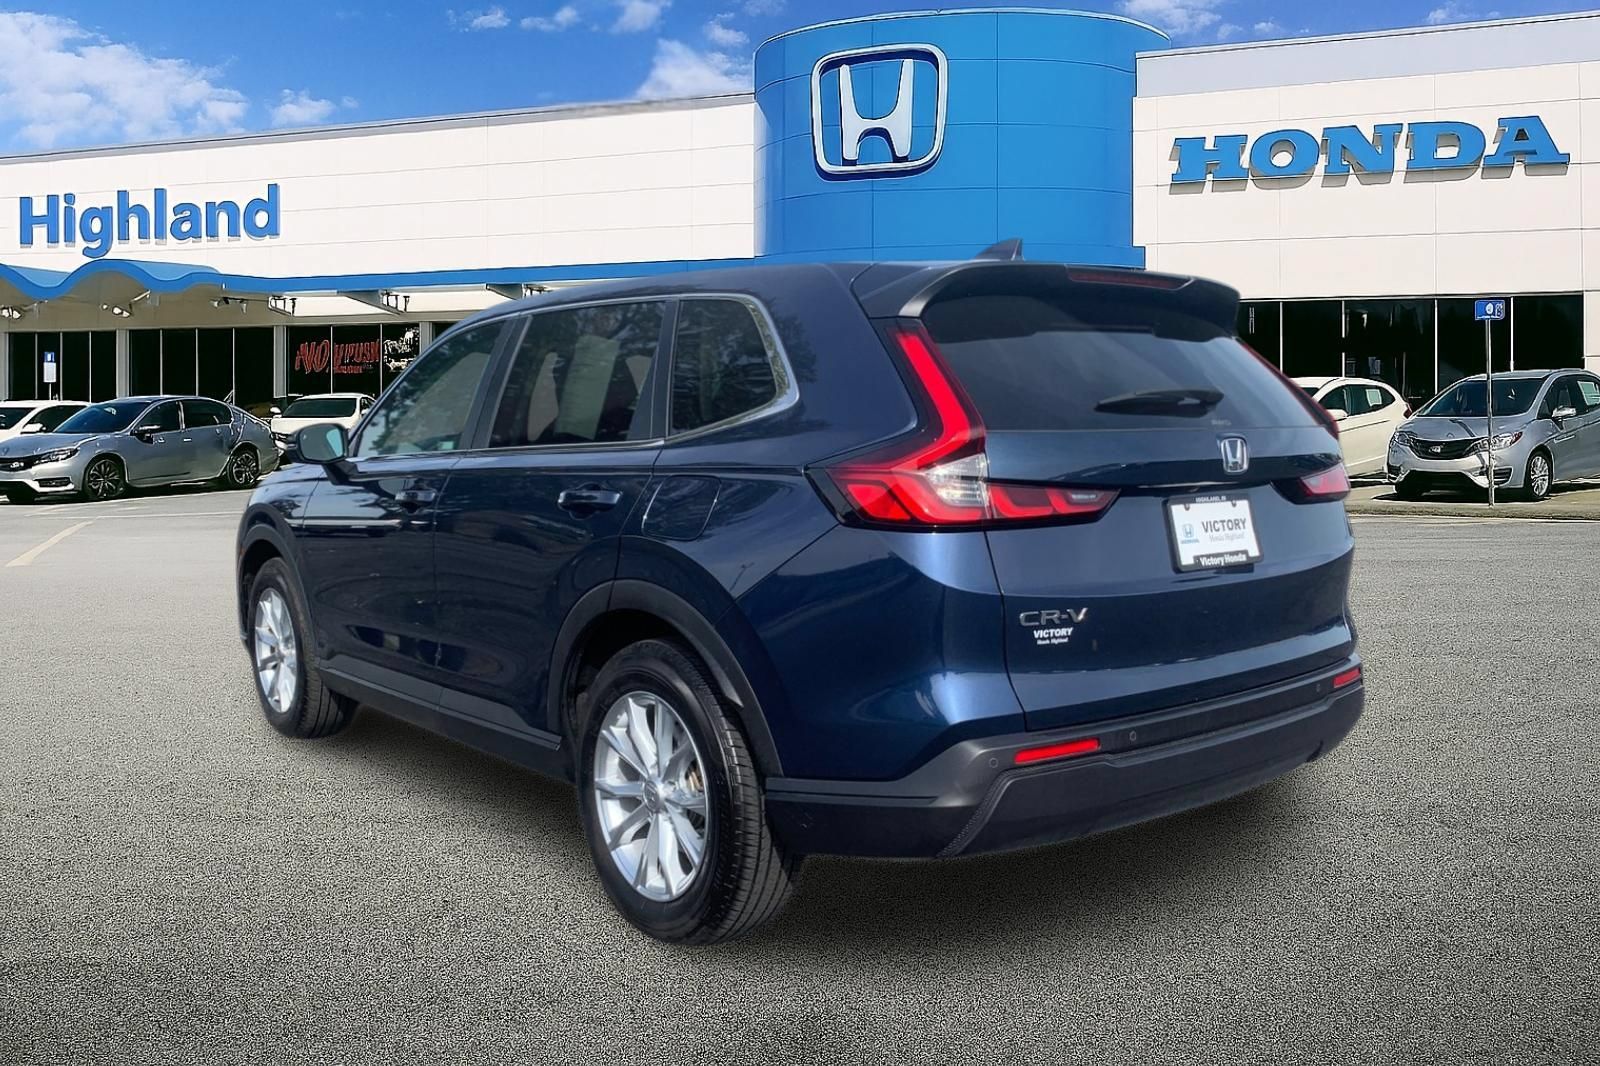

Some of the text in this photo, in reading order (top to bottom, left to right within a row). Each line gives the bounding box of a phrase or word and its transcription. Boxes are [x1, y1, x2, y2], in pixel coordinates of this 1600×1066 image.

[1170, 115, 1571, 185] HONDA
[19, 183, 281, 259] Highland
[1201, 518, 1246, 533] VICTORY
[1199, 553, 1247, 567] Victory Honda
[1019, 607, 1089, 627] CR-V
[1033, 626, 1074, 639] VICTORY
